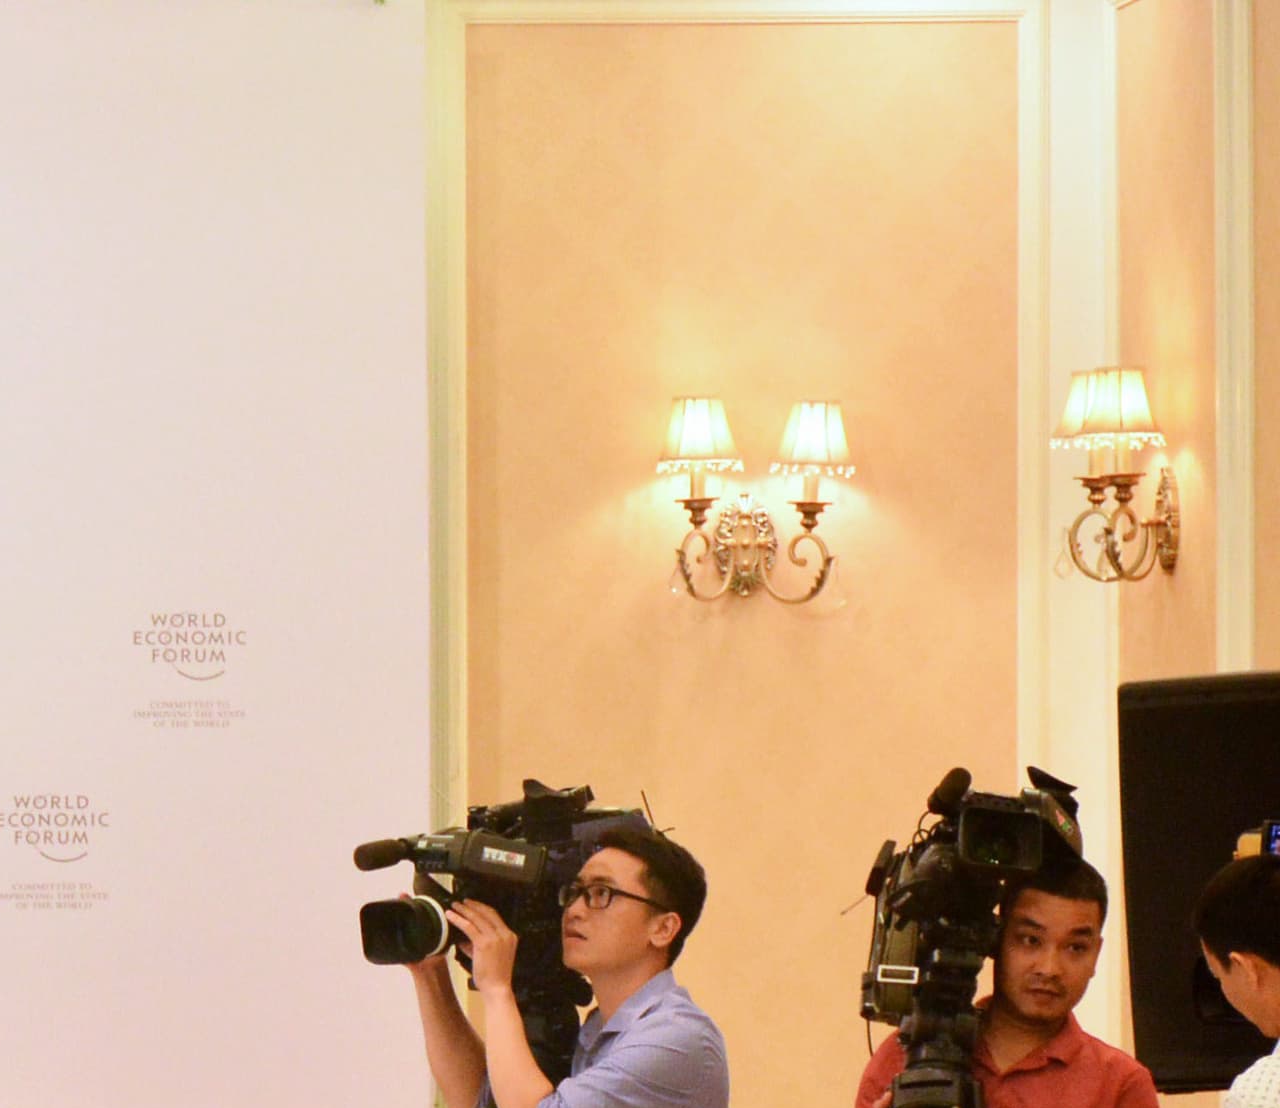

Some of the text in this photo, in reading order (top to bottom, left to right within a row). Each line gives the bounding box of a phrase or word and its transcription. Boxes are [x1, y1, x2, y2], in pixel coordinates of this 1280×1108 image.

[151, 614, 227, 628] WORLD
[133, 631, 248, 646] ECONOMIC
[152, 649, 227, 663] FORUM
[13, 795, 89, 809] WORLD
[14, 830, 89, 844] FORUM
